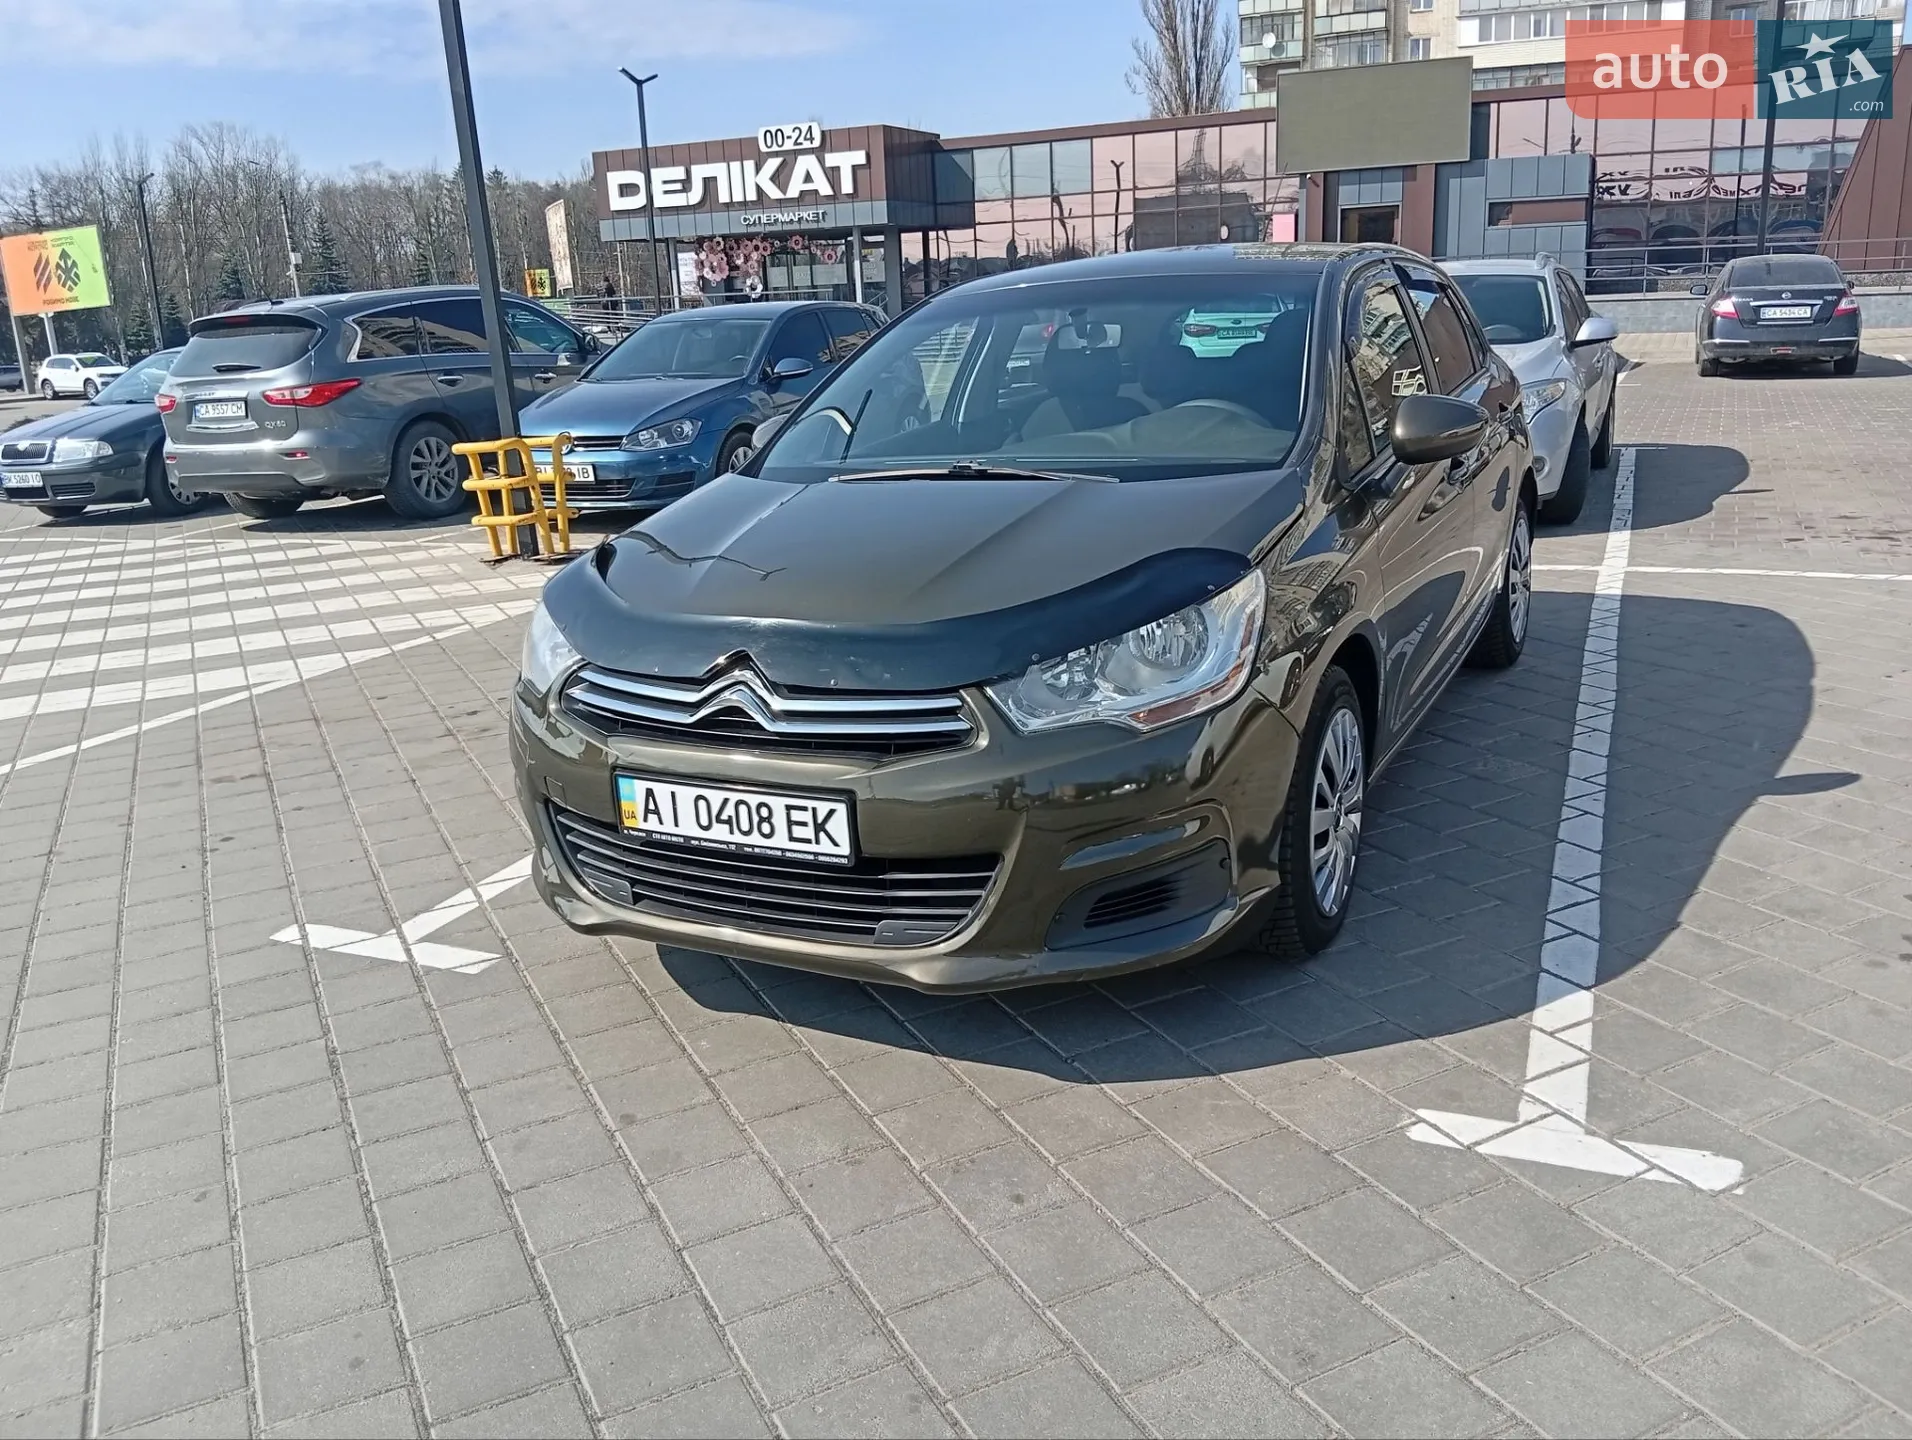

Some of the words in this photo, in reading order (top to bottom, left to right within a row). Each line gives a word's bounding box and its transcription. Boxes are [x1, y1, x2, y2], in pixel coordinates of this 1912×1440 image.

[763, 125, 815, 148] 00-24
[740, 210, 826, 225] СУПЕРМАРКЕТ
[200, 406, 210, 416] CA
[212, 404, 228, 414] 9557
[624, 809, 637, 820] UA
[643, 788, 679, 827] AI
[694, 795, 775, 839] 0408
[785, 804, 840, 847] EK
